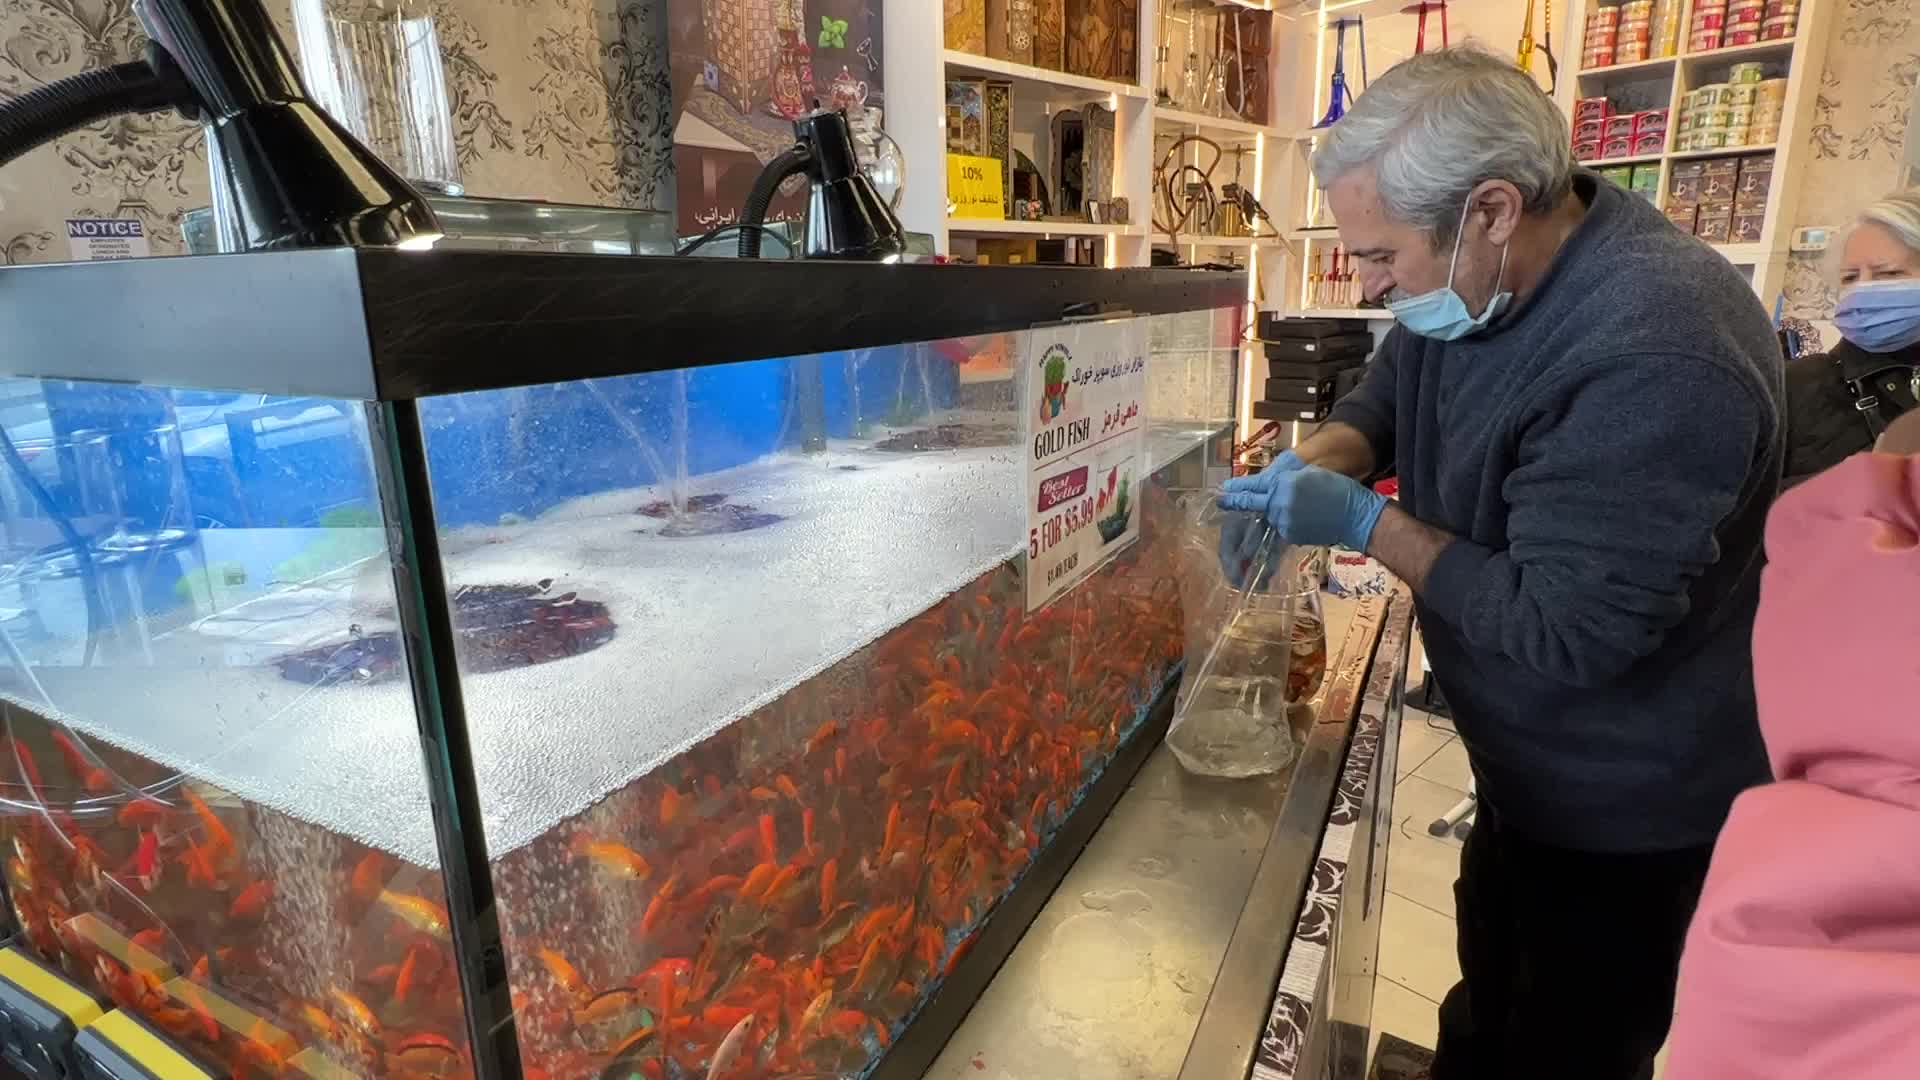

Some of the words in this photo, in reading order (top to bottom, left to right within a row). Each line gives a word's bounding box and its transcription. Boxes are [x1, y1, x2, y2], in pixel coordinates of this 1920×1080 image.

[961, 166, 983, 181] 10%
[67, 222, 143, 235] NOTICE
[1034, 423, 1065, 461] GOLD
[1067, 416, 1092, 445] FISH
[1042, 475, 1070, 495] Best
[1048, 483, 1084, 506] Seller
[1029, 526, 1040, 560] 5
[1041, 514, 1062, 553] FOR
[1064, 495, 1094, 538] $5.99
